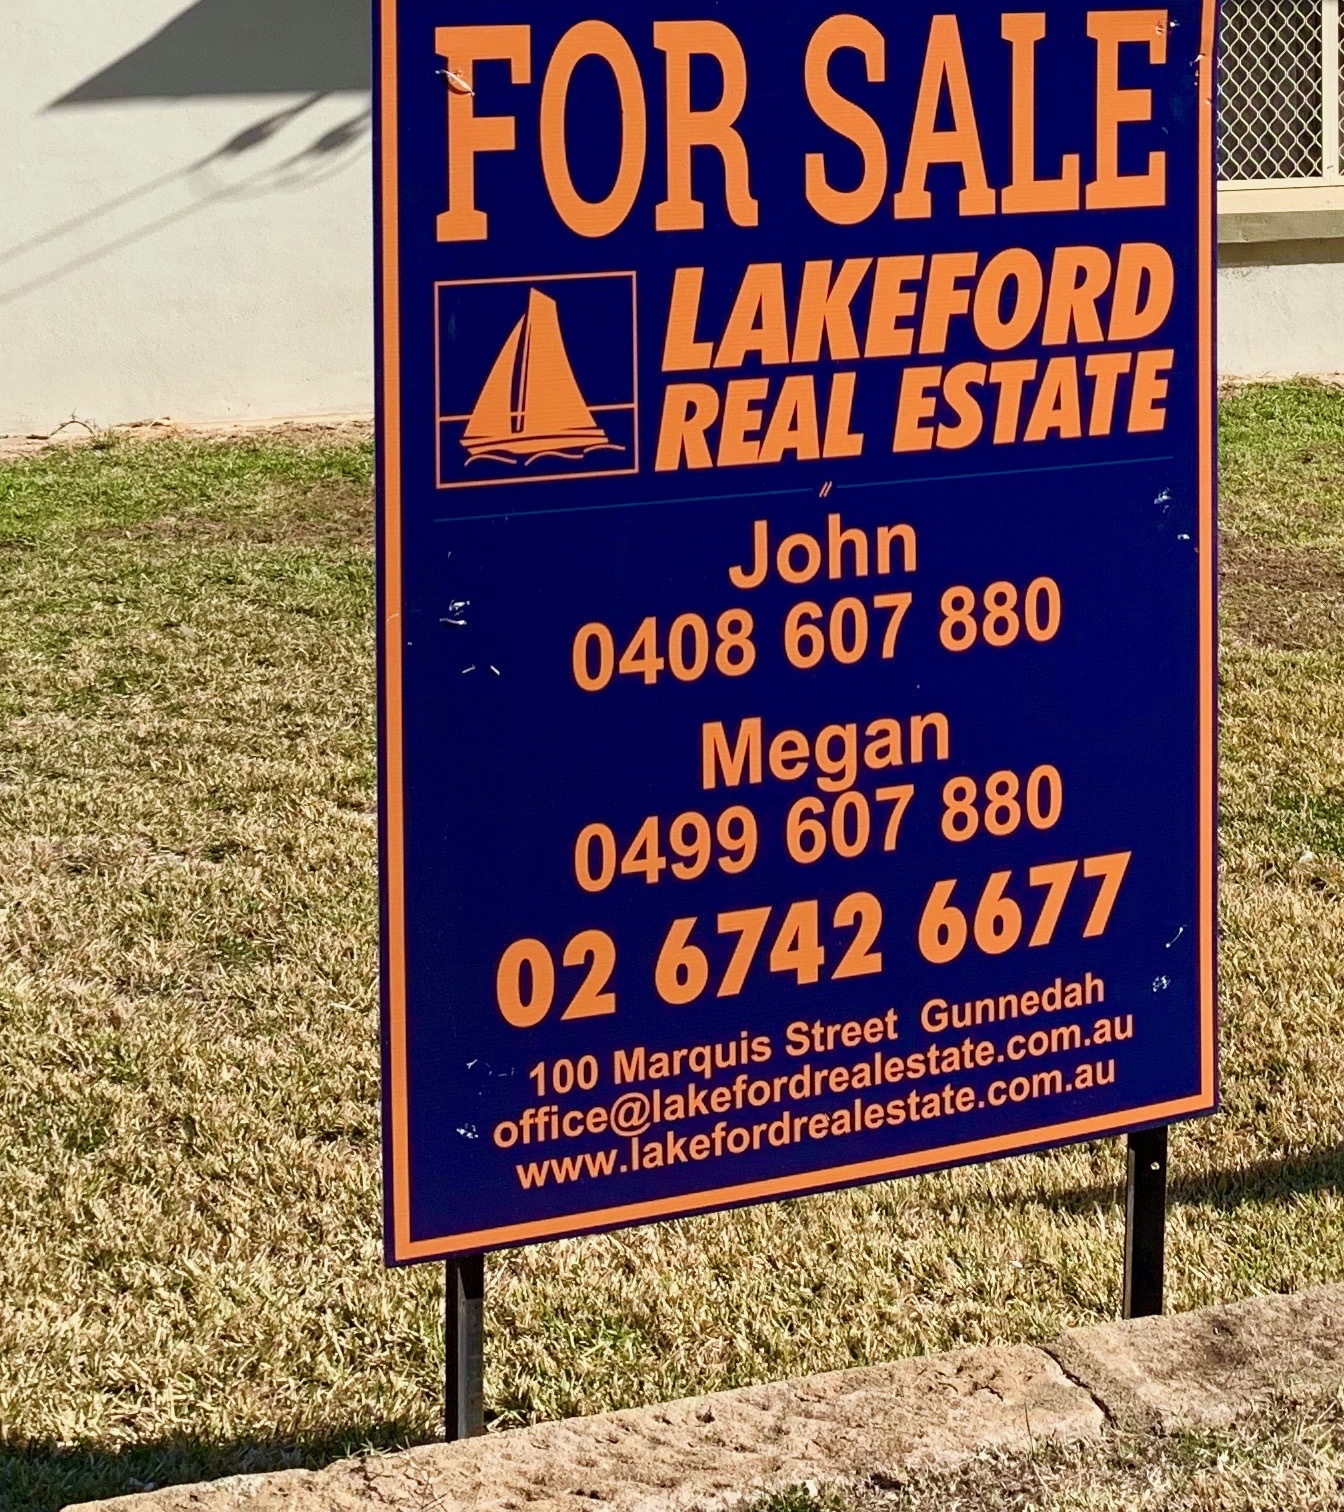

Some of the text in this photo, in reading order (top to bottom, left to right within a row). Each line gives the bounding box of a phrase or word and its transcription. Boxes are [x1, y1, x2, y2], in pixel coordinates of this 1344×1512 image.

[435, 10, 1167, 242] FOR SALE
[662, 243, 1174, 371] LAKEFORD
[655, 349, 1174, 471] REAL ESTATE
[729, 514, 916, 588] John
[573, 577, 1060, 691] 0408 607 880
[703, 713, 948, 792] Megan
[575, 765, 1062, 891] 0499 607 880
[497, 852, 1131, 1027] 02 6742 6677
[494, 1014, 1133, 1148] office@lakefordrealestate.com.au
[530, 973, 1103, 1096] 100 Marquis Street Gunnedah
[516, 1059, 1115, 1189] www.lakefordrealestate.com.au
